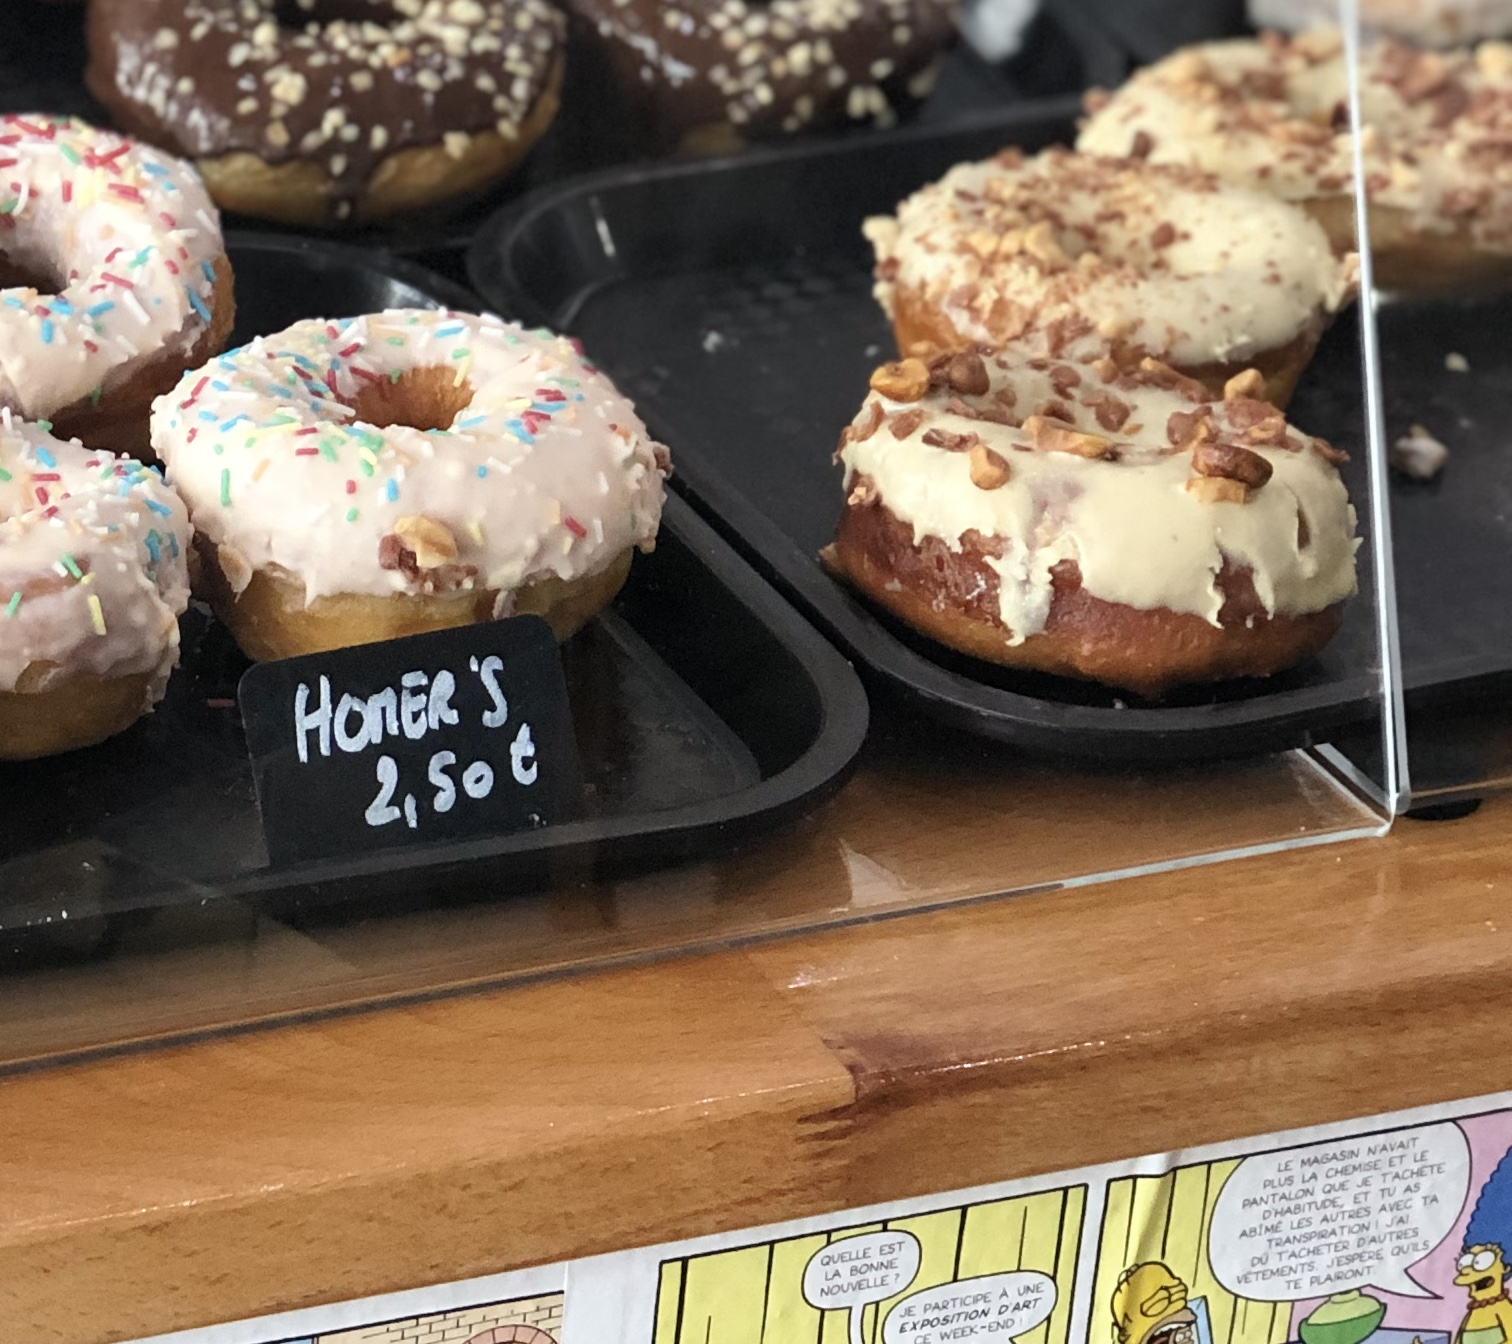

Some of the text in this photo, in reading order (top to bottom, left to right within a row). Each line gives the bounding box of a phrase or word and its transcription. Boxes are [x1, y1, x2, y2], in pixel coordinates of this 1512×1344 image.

[295, 655, 508, 764] HOMER'S
[365, 750, 494, 829] 2,50
[819, 1241, 905, 1267] QUELLE EST
[825, 1258, 900, 1282] LA BONNE
[819, 1274, 890, 1298] NOUVELLE
[899, 1305, 916, 1319] JE
[923, 1291, 992, 1315] PARTICIPE
[1017, 1281, 1045, 1297] UNE
[898, 1297, 1043, 1334] EXPOSITION D'ART
[939, 1318, 1015, 1342] WEEK-END
